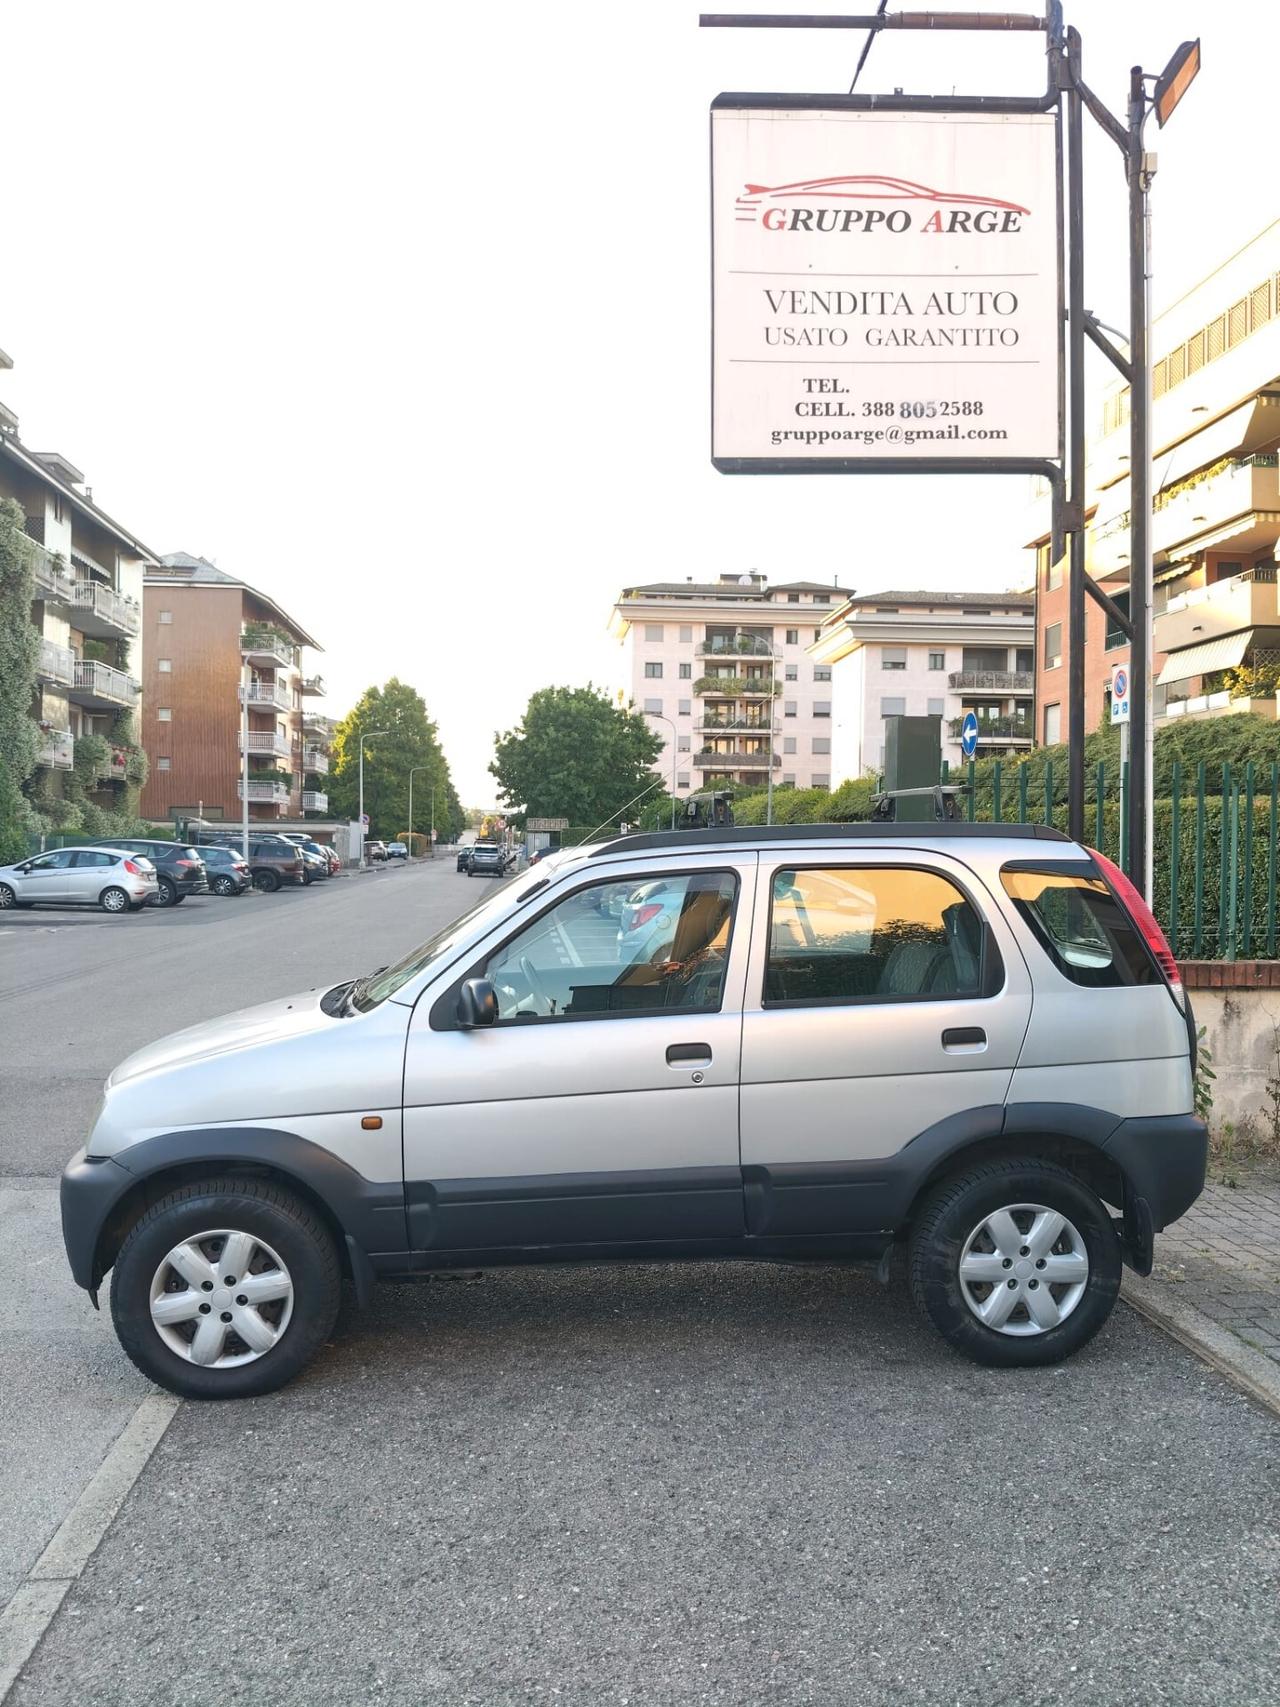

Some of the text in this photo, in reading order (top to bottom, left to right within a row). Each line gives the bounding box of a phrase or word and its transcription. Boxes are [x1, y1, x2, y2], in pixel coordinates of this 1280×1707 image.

[763, 208, 1022, 234] GRUPPO ARGE
[763, 289, 1019, 316] VENDITA AUTO
[764, 326, 1020, 347] USATO GARANTITO
[803, 378, 850, 394] TEL.
[794, 401, 856, 417] CELL.
[861, 401, 895, 417] 388
[939, 400, 984, 417] 2588
[771, 424, 1009, 446] gruppoarge@gmail.com
